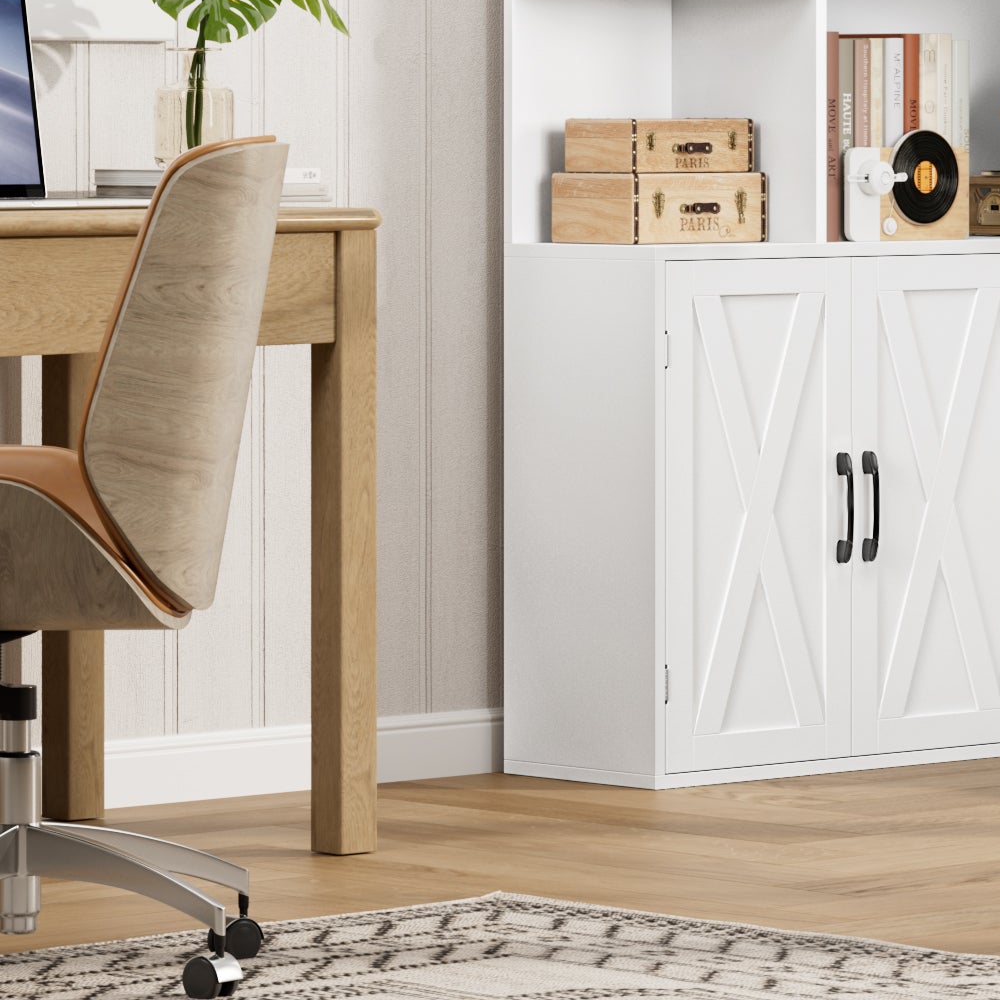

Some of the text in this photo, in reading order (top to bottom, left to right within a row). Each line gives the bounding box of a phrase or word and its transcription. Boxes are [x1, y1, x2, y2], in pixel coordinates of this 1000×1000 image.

[828, 99, 836, 132] MOVE
[842, 93, 852, 135] HAUTE
[675, 157, 710, 168] PARIS
[680, 216, 720, 231] PARIS
